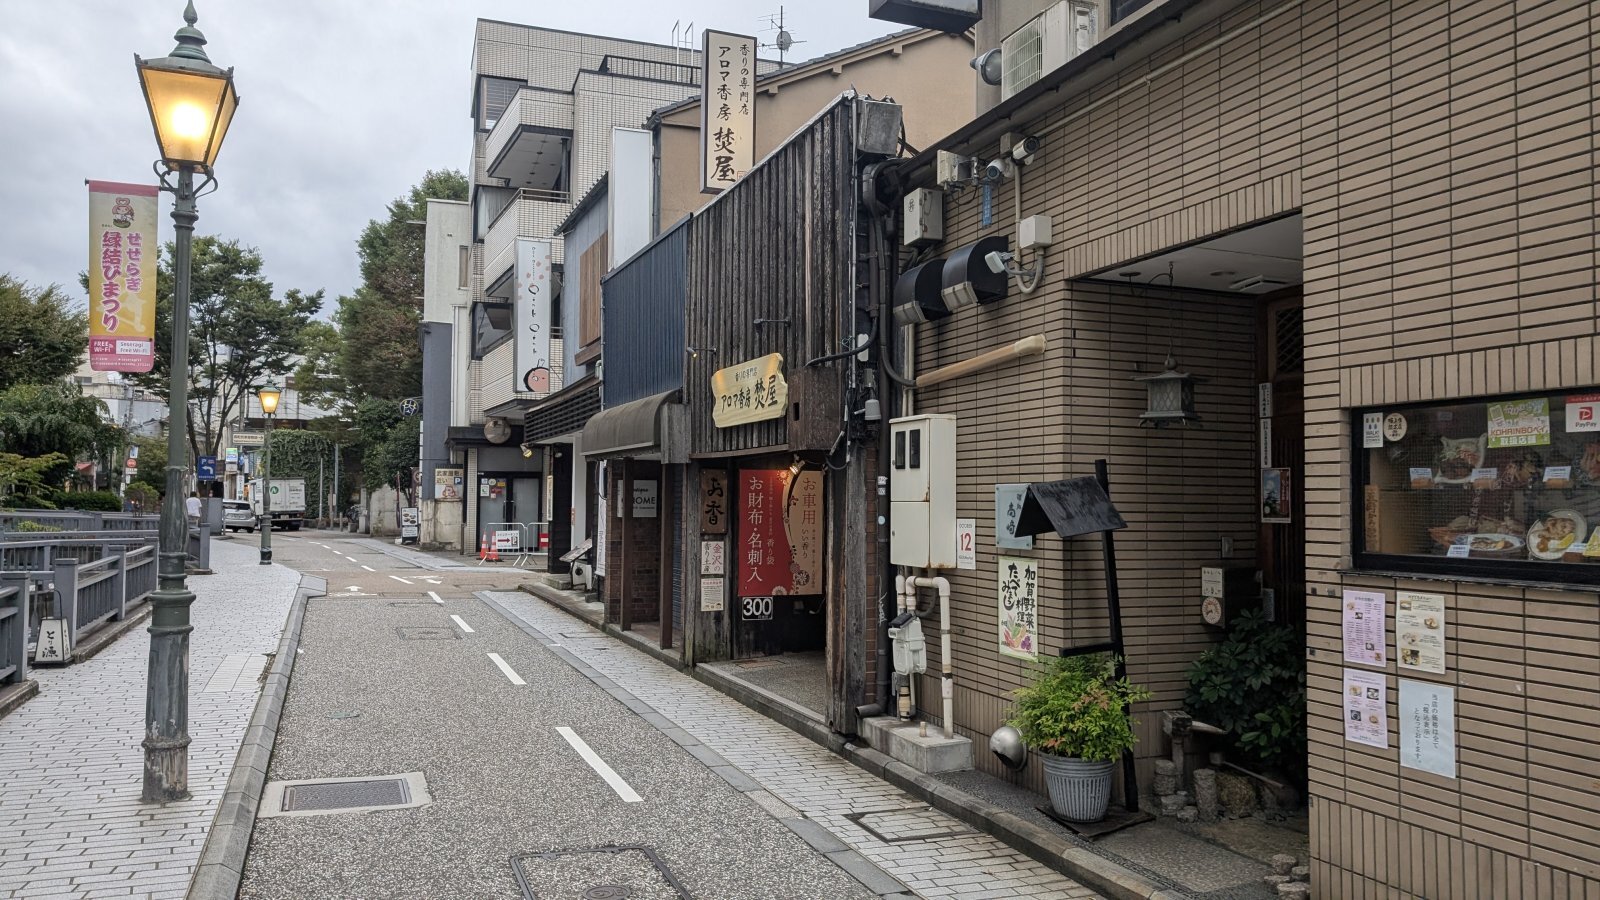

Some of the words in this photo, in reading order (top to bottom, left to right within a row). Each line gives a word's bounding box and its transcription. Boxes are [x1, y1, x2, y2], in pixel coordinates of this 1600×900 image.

[738, 44, 751, 116] 香りの専門店
[101, 230, 122, 333] 縁結びまつり
[126, 231, 142, 293] せせらぎ
[704, 476, 725, 526] お香
[801, 477, 817, 525] お車用
[711, 543, 723, 572] 金沢の
[960, 532, 972, 552] 12
[743, 598, 772, 616] 300
[1023, 563, 1037, 630] 加賀野菜
